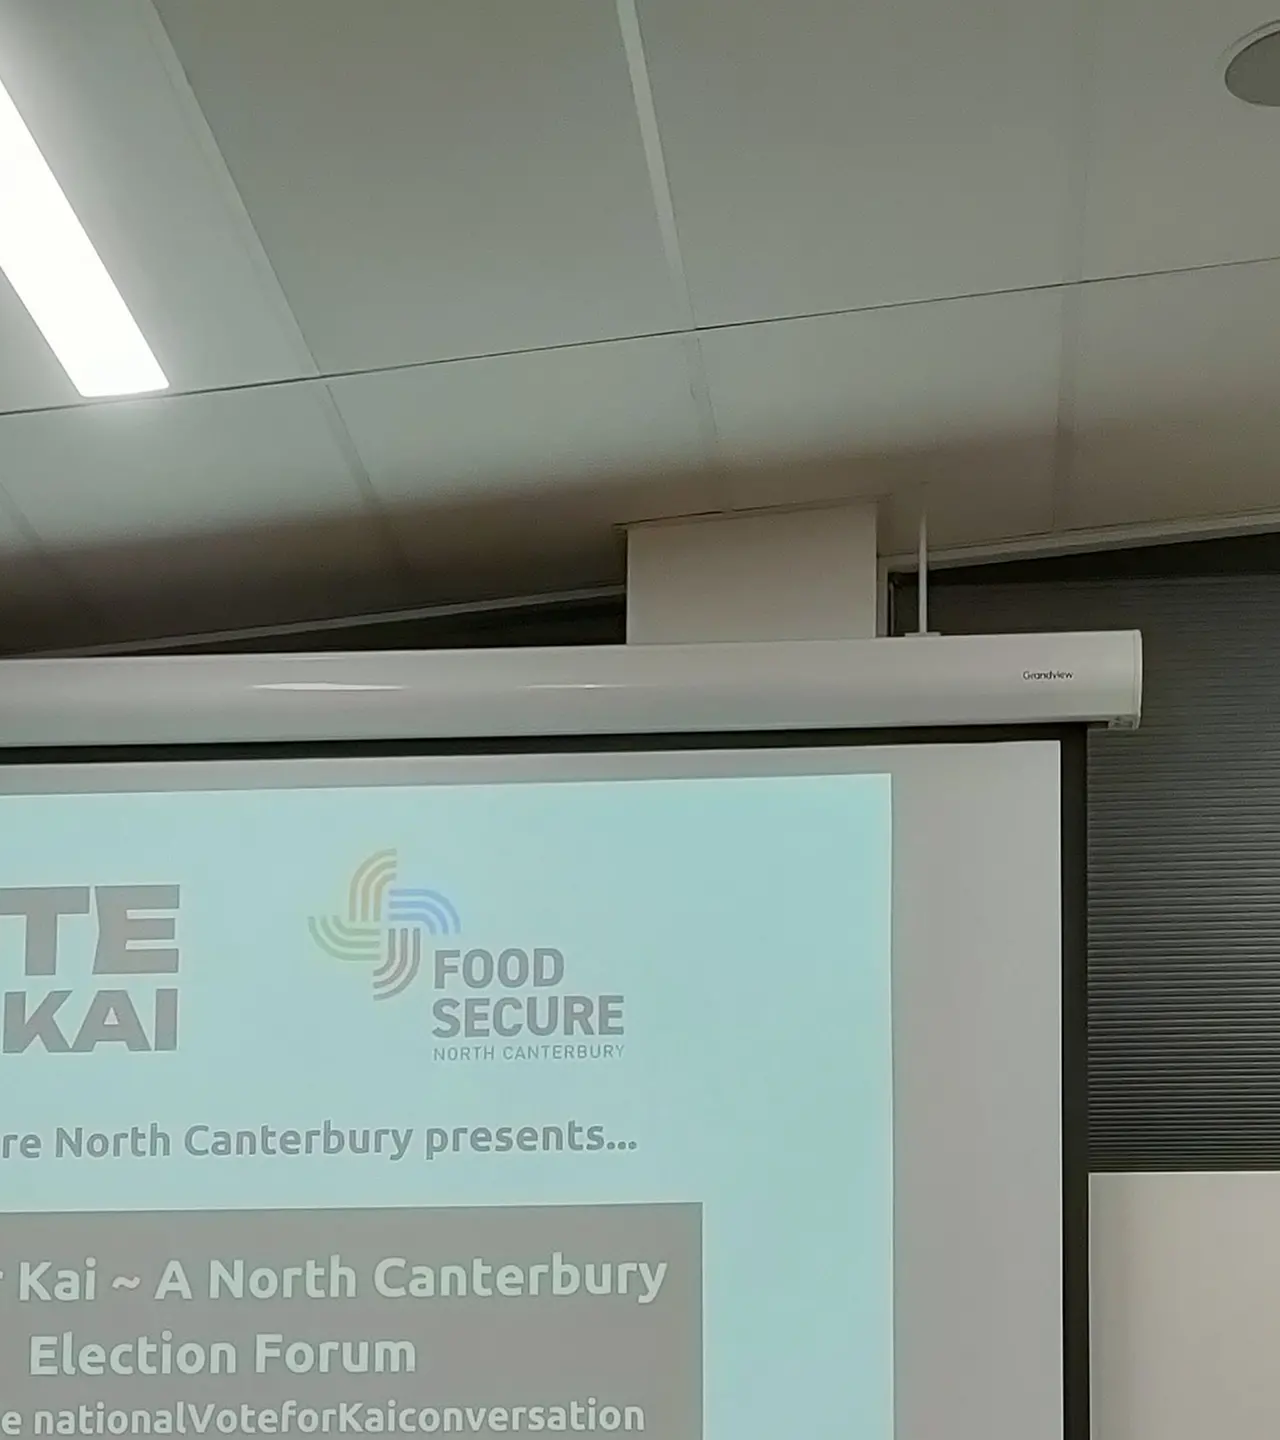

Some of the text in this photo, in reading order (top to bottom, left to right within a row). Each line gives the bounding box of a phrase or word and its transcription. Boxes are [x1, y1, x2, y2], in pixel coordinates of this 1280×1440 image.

[434, 947, 565, 990] FOOD
[2, 988, 178, 1054] KAI
[431, 994, 625, 1039] SECURE
[433, 1044, 625, 1061] NORTH CANTERBURY
[55, 1122, 171, 1158] North
[184, 1119, 414, 1161] Canterbury
[426, 1119, 637, 1161] presents...
[19, 1257, 96, 1301] Kai
[154, 1260, 193, 1300] A
[209, 1254, 356, 1299] North
[374, 1251, 668, 1304] Canterbury
[30, 1330, 416, 1375] Election Forum
